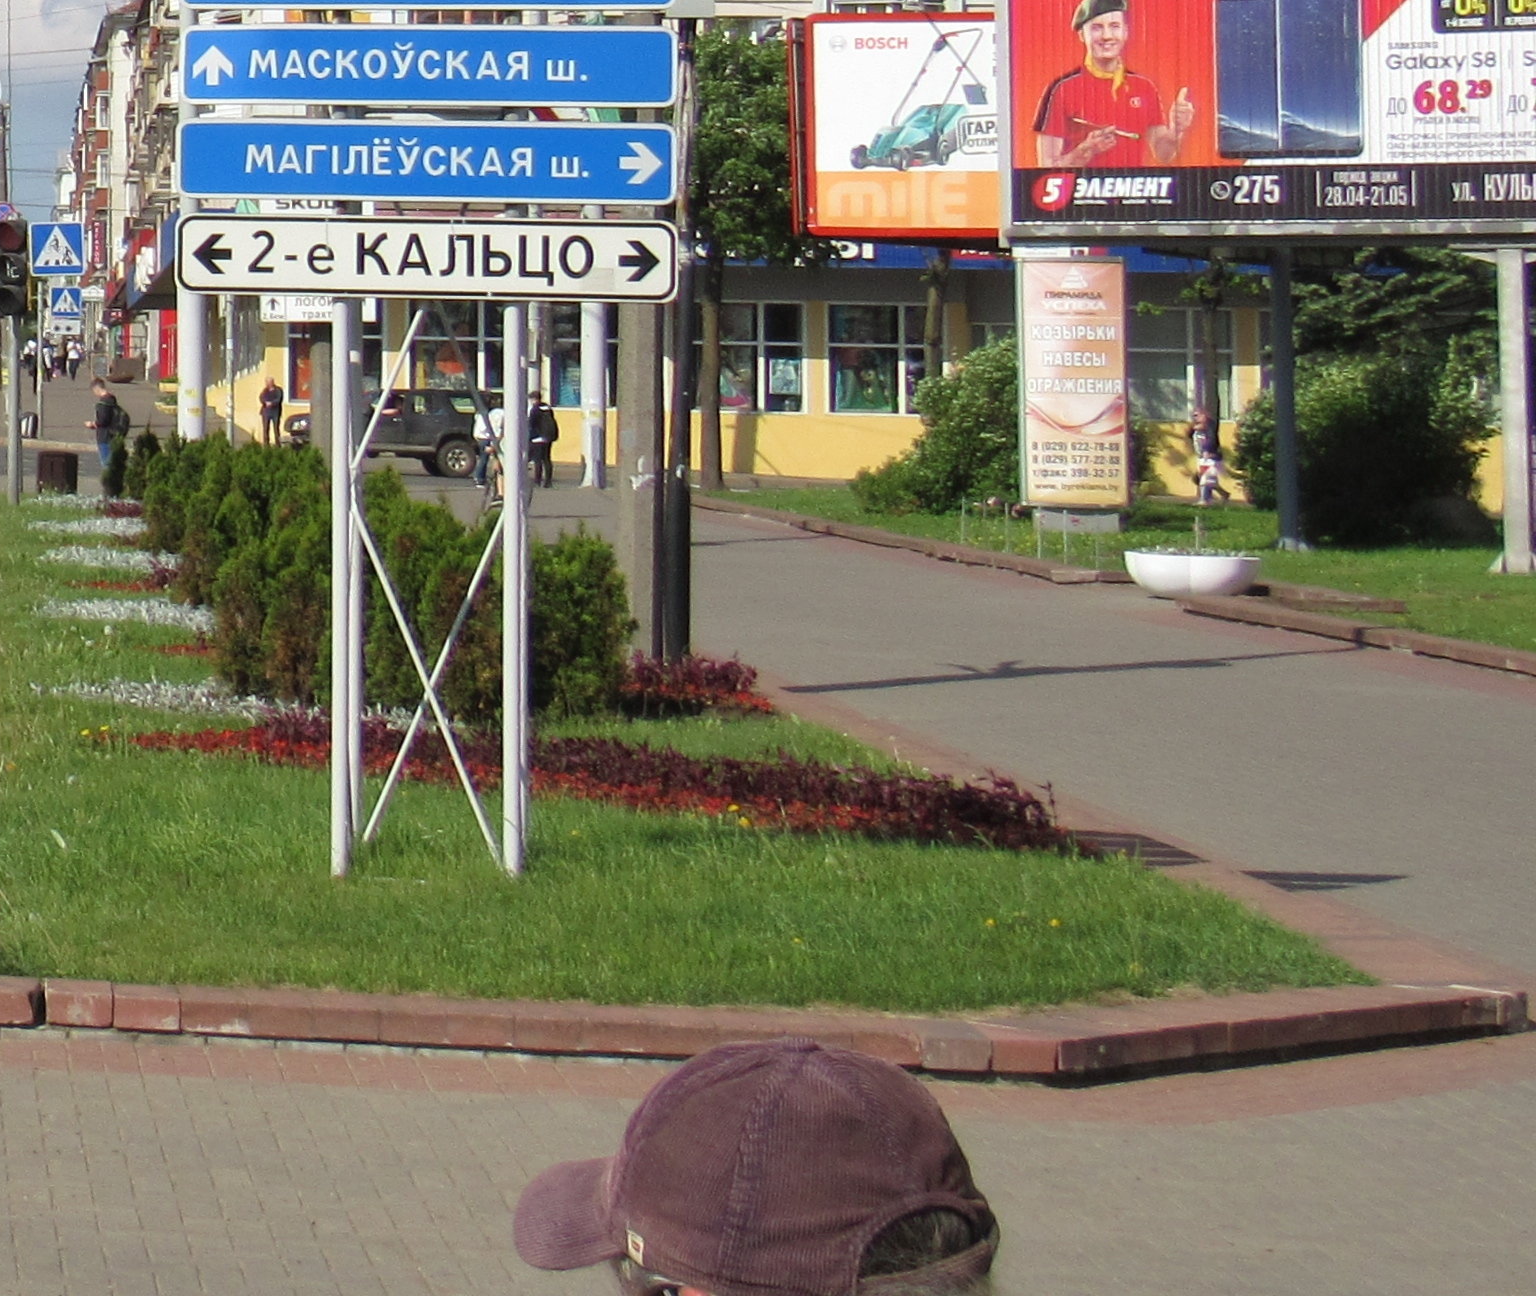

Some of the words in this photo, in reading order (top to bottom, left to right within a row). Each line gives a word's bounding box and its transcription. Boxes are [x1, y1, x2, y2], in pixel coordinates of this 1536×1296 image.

[854, 36, 909, 50] BOSCH
[247, 41, 530, 81] МАСКОЎСКАЯ
[545, 58, 589, 82] ш.
[1385, 53, 1467, 72] Galaxy
[1471, 51, 1497, 68] S8
[1386, 97, 1408, 117] ДО
[244, 137, 534, 178] МАГІЛЁЎСКАЯ
[550, 156, 591, 178] ш.
[1042, 177, 1063, 203] 5
[1073, 177, 1172, 198] ЭЛЕМЕНТ
[1233, 175, 1280, 204] 275
[1324, 185, 1408, 206] 28.04-21.05
[1451, 181, 1476, 202] ул.
[247, 230, 336, 275] 2-е
[355, 232, 595, 287] КАЛЬЦО
[1031, 324, 1117, 341] КОЗЫРЬКИ
[1042, 350, 1106, 367] НАВЕСЫ
[1027, 378, 1123, 394] ОГРАЖДЕНИЯ
